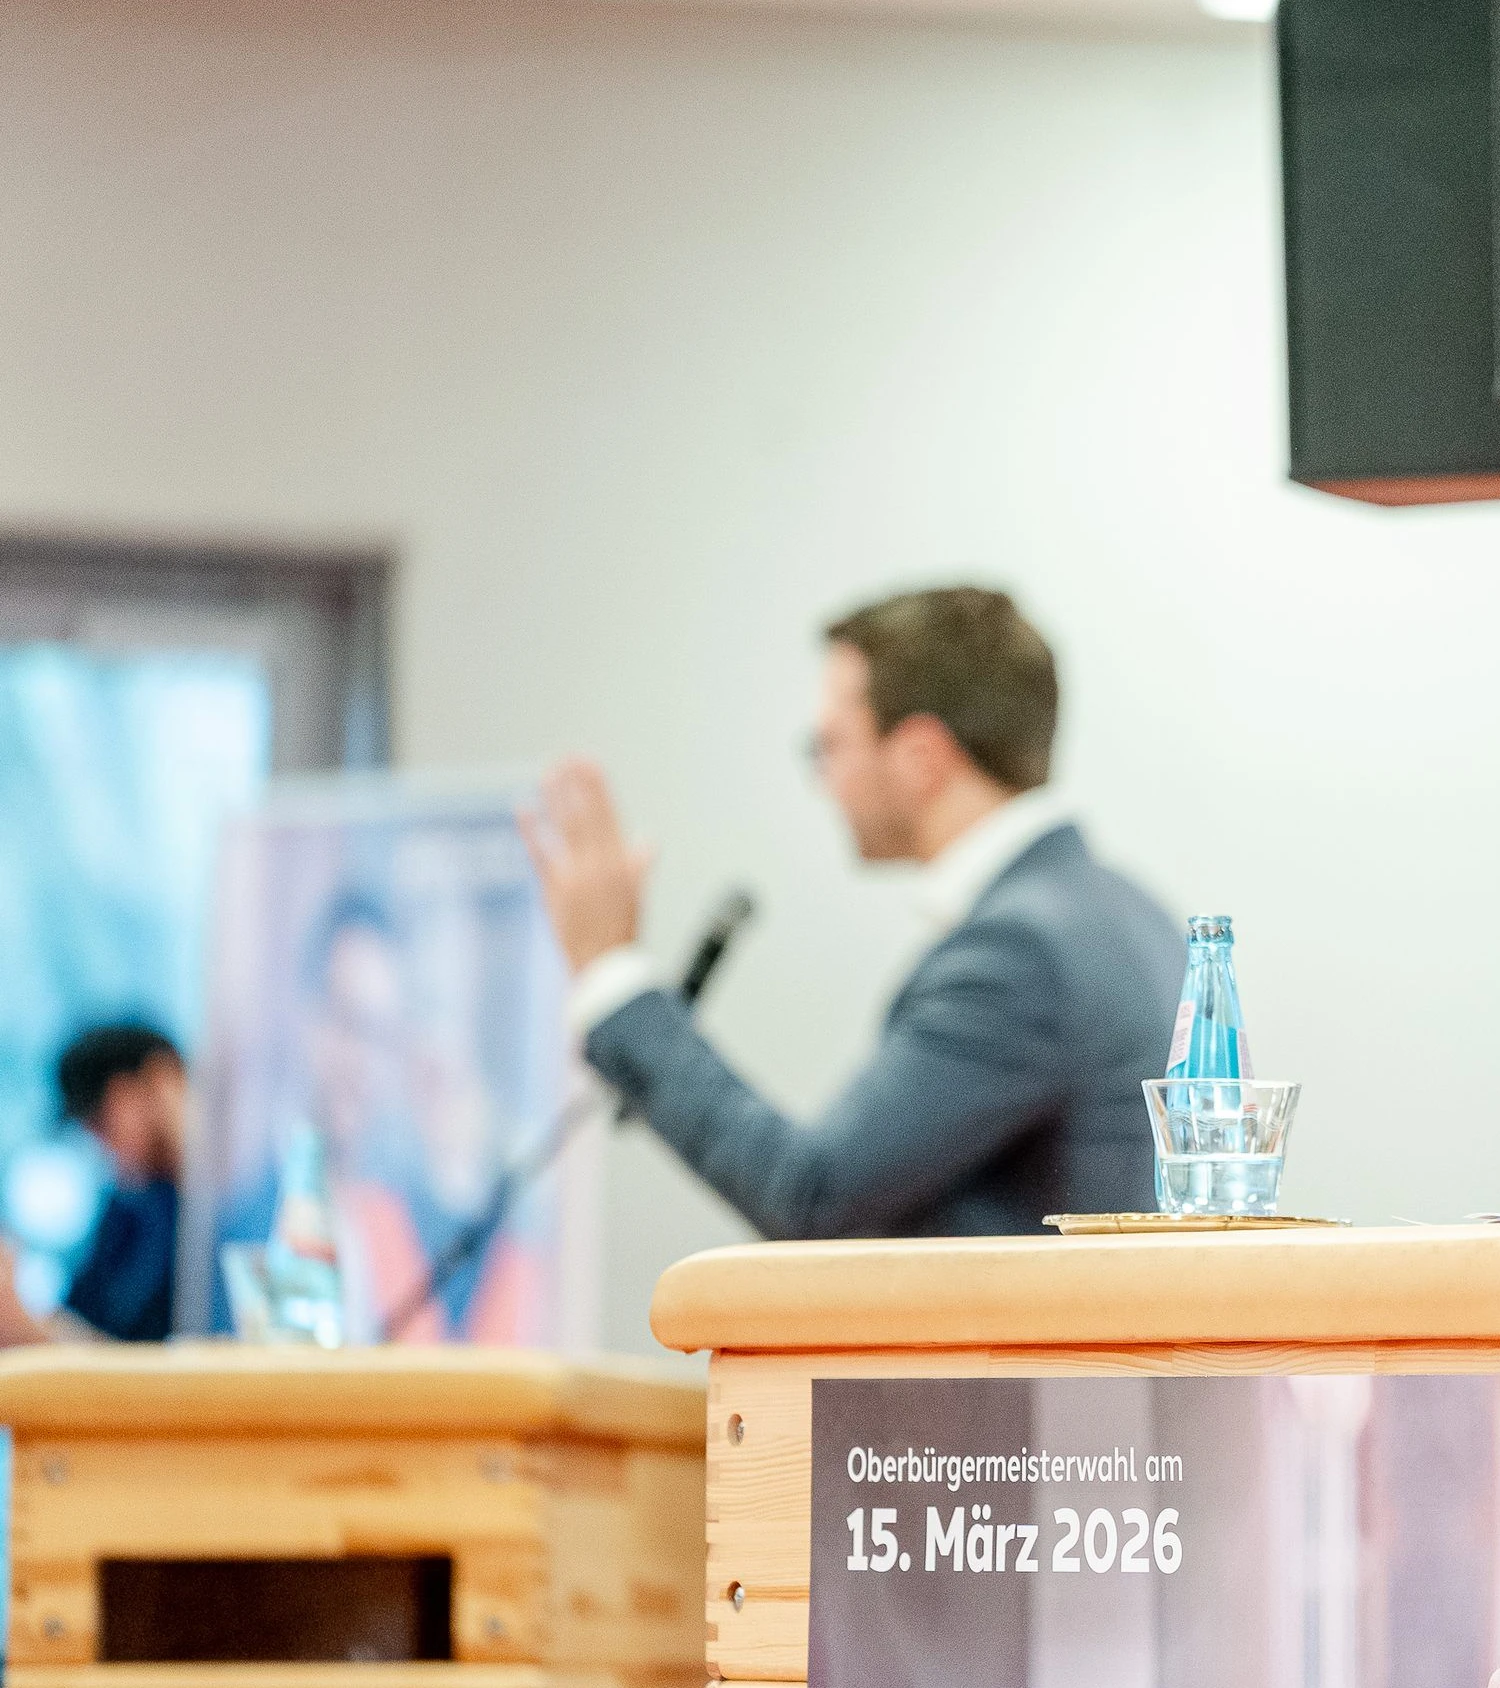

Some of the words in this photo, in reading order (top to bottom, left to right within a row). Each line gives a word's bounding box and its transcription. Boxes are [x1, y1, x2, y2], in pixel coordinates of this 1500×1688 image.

[847, 1446, 1138, 1492] Oberbürgermeisterwahl
[1145, 1454, 1183, 1482] am
[846, 1507, 911, 1573] 15.
[925, 1503, 1039, 1573] März
[1052, 1507, 1183, 1574] 2026
